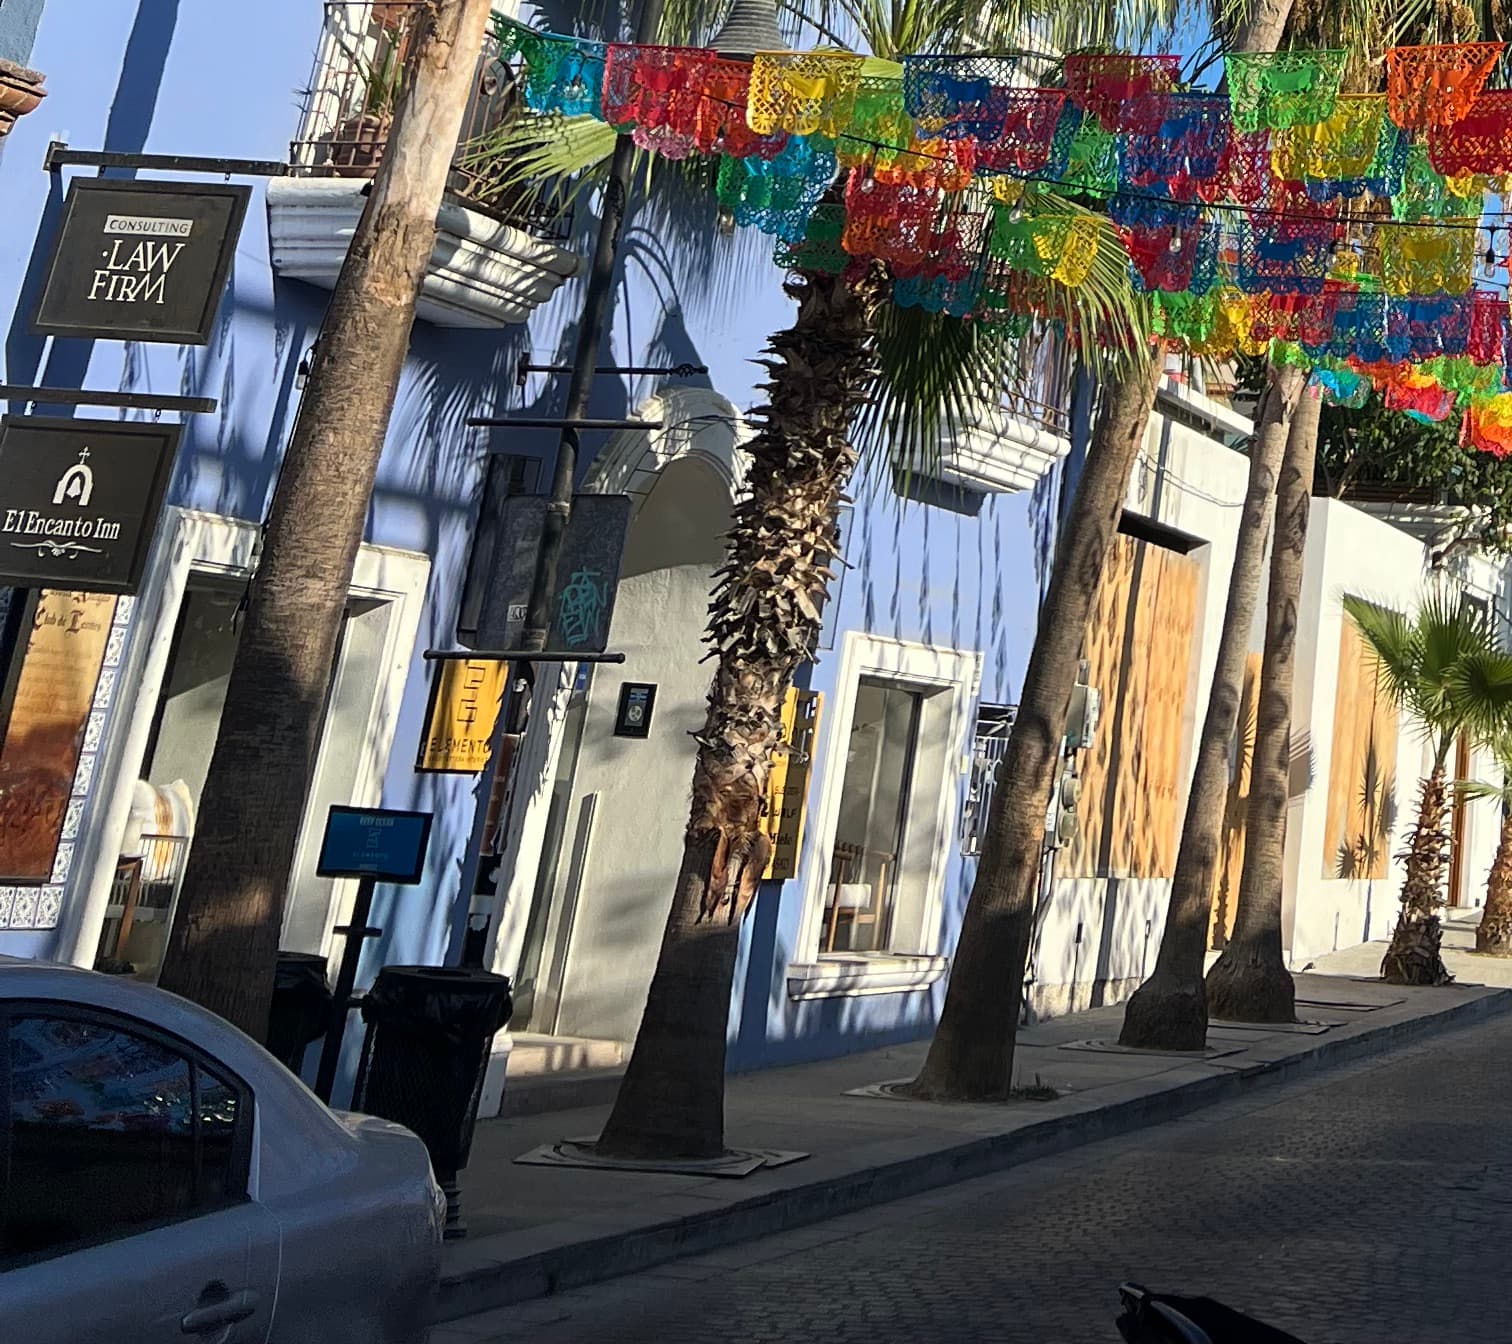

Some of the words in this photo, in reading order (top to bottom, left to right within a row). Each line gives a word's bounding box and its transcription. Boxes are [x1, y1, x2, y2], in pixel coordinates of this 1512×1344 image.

[109, 219, 189, 234] CONSULTING
[106, 239, 186, 273] LAW
[87, 269, 166, 304] FIRM
[2, 509, 25, 533] El
[24, 511, 93, 538] Encanto
[93, 518, 120, 540] Inn
